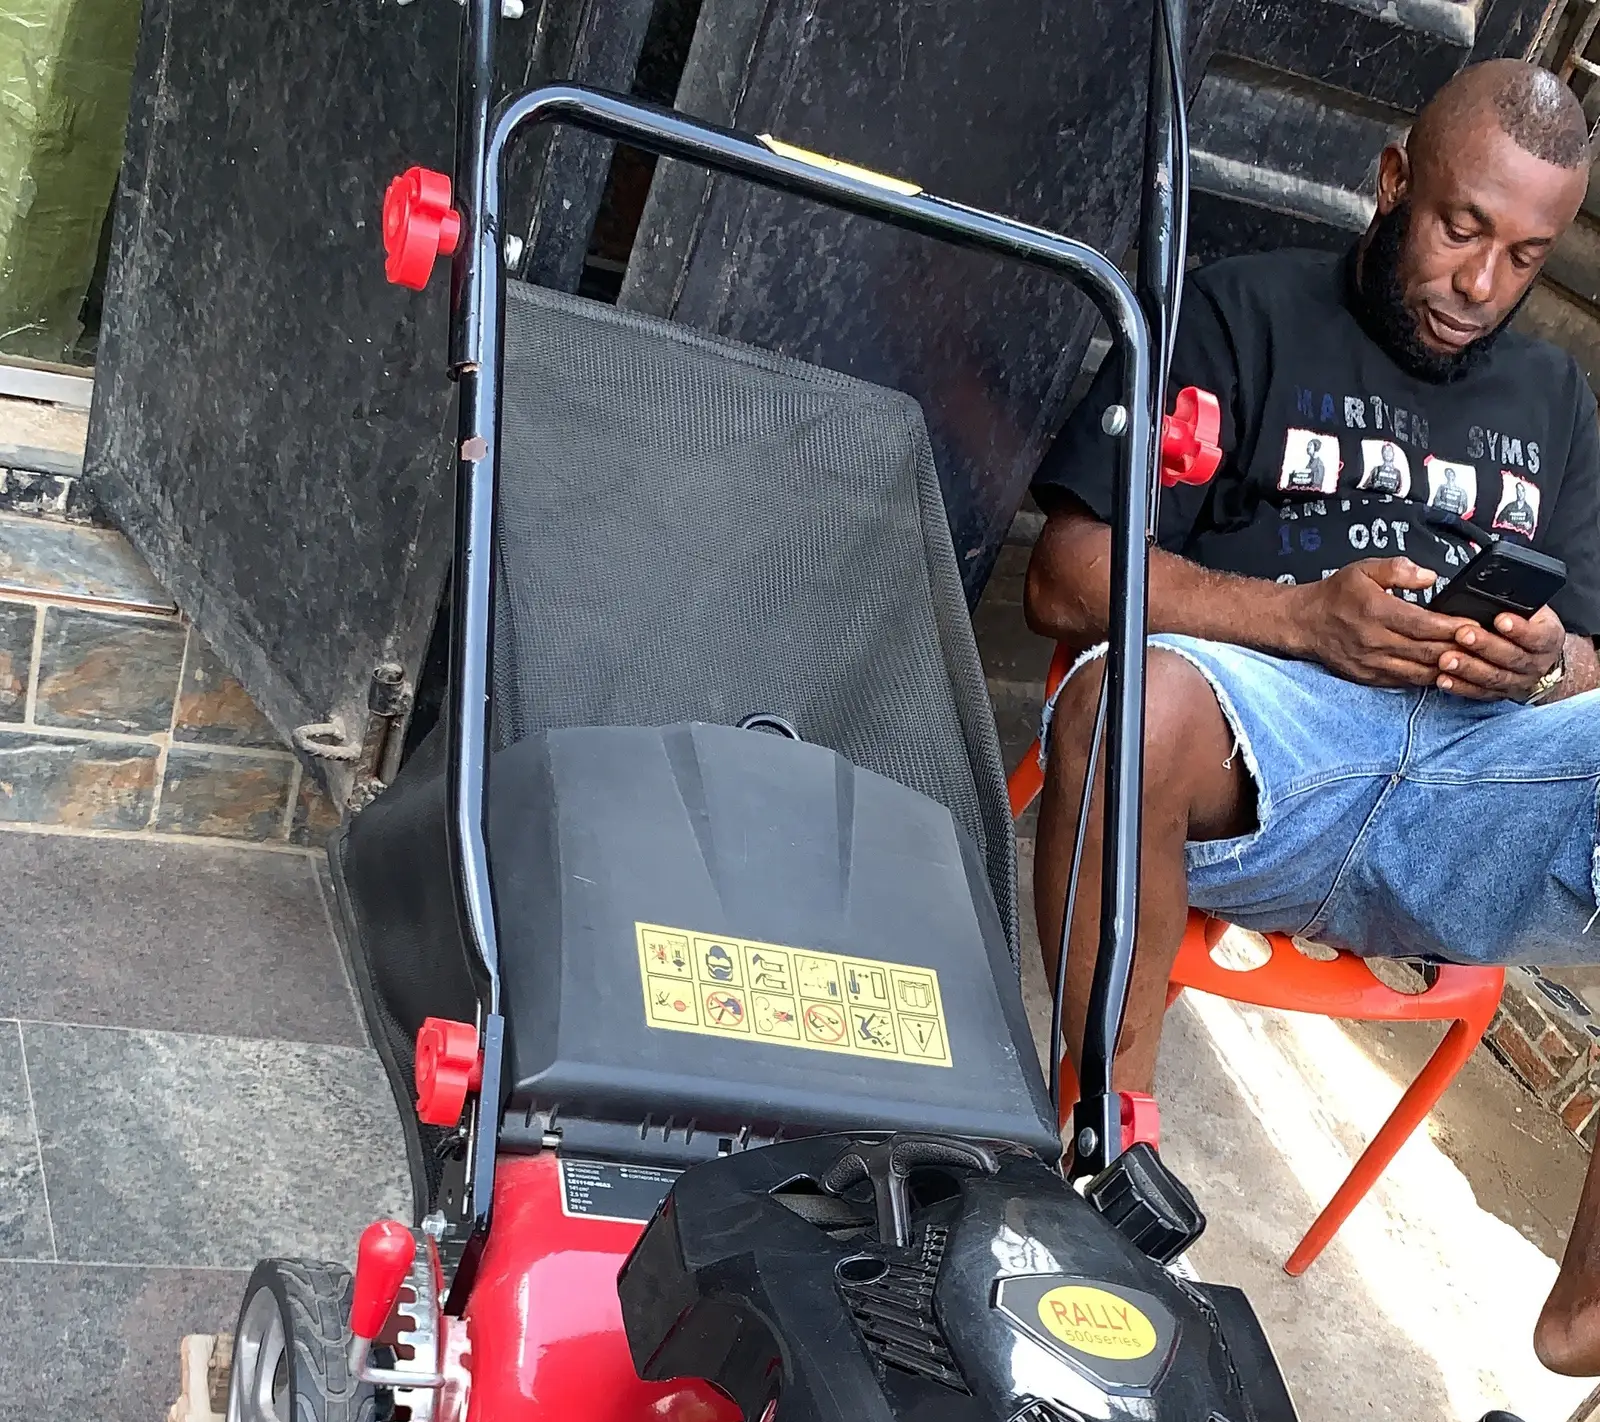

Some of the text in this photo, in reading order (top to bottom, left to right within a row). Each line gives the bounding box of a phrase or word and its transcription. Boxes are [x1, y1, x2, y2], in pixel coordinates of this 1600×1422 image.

[1466, 424, 1542, 475] SYMS
[1277, 523, 1323, 556] 16
[1348, 517, 1411, 552] OCT
[1048, 1300, 1132, 1332] RALLY
[1065, 1329, 1142, 1348] 500series
